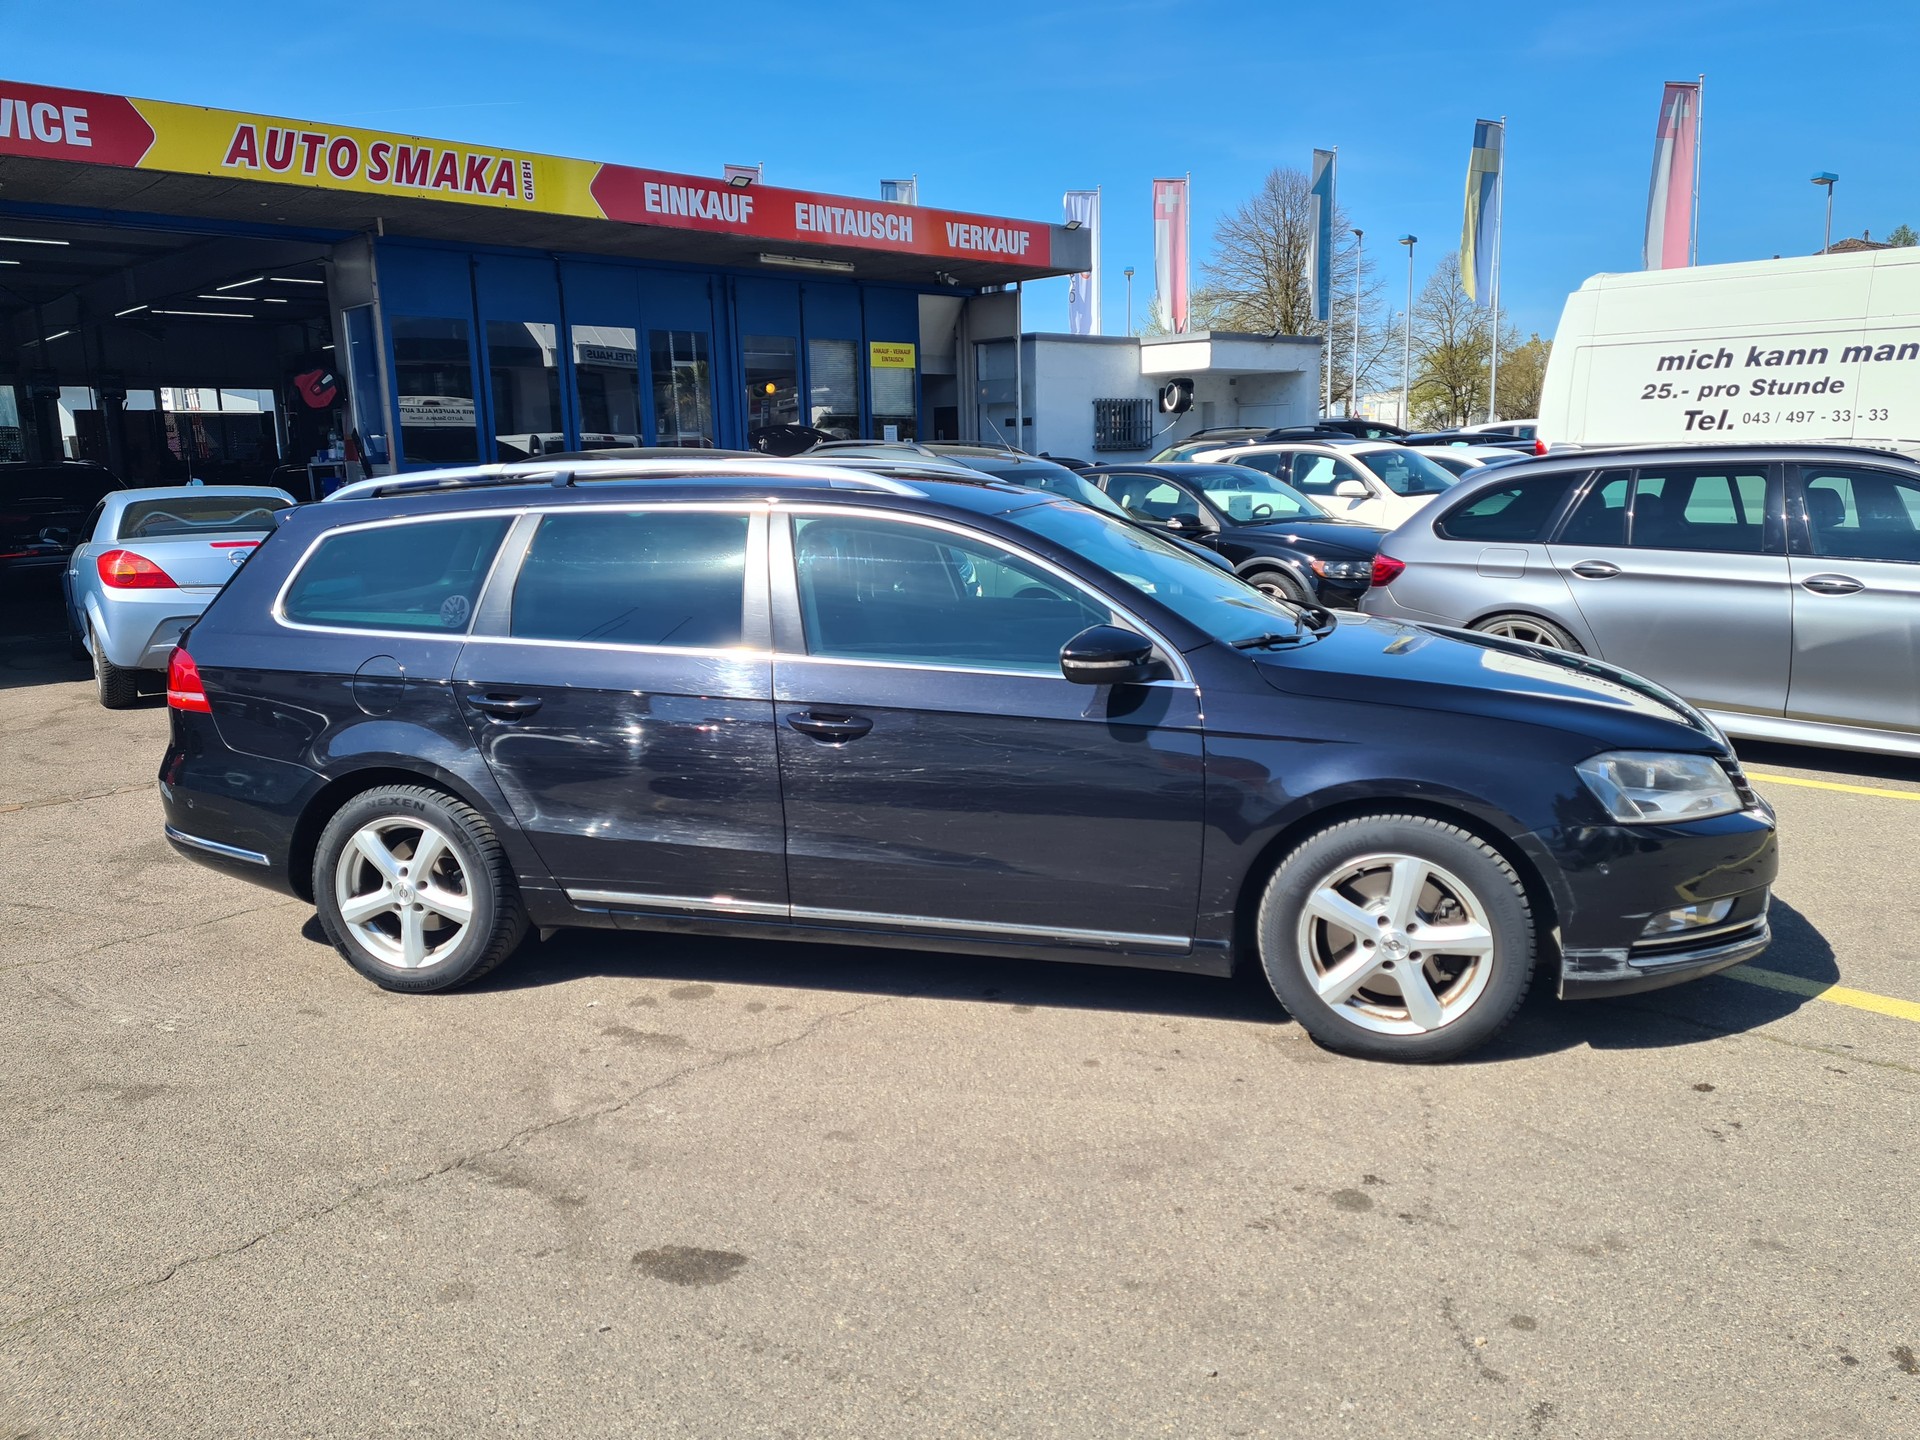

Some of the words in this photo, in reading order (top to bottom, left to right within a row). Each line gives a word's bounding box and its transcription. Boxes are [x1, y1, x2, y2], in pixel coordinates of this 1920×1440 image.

[222, 123, 360, 181] AUTO
[365, 140, 518, 198] SMAKA
[523, 161, 534, 201] GMBH
[643, 181, 754, 224] EINKAUF
[794, 202, 913, 242] EINTAUSCH
[945, 221, 1030, 255] VERKAUF
[881, 355, 904, 363] EINTAUSCH
[1656, 347, 1734, 372] mich
[1744, 345, 1829, 368] kann
[1839, 342, 1920, 364] man
[1640, 383, 1689, 399] 25.-
[1696, 384, 1741, 401] pro
[1749, 376, 1845, 397] Stunde
[1684, 409, 1735, 431] Tel.
[1742, 412, 1770, 424] 043
[1785, 410, 1815, 423] 497
[1831, 409, 1851, 422] 33
[1868, 408, 1889, 421] 33
[365, 797, 425, 812] NEXEN
